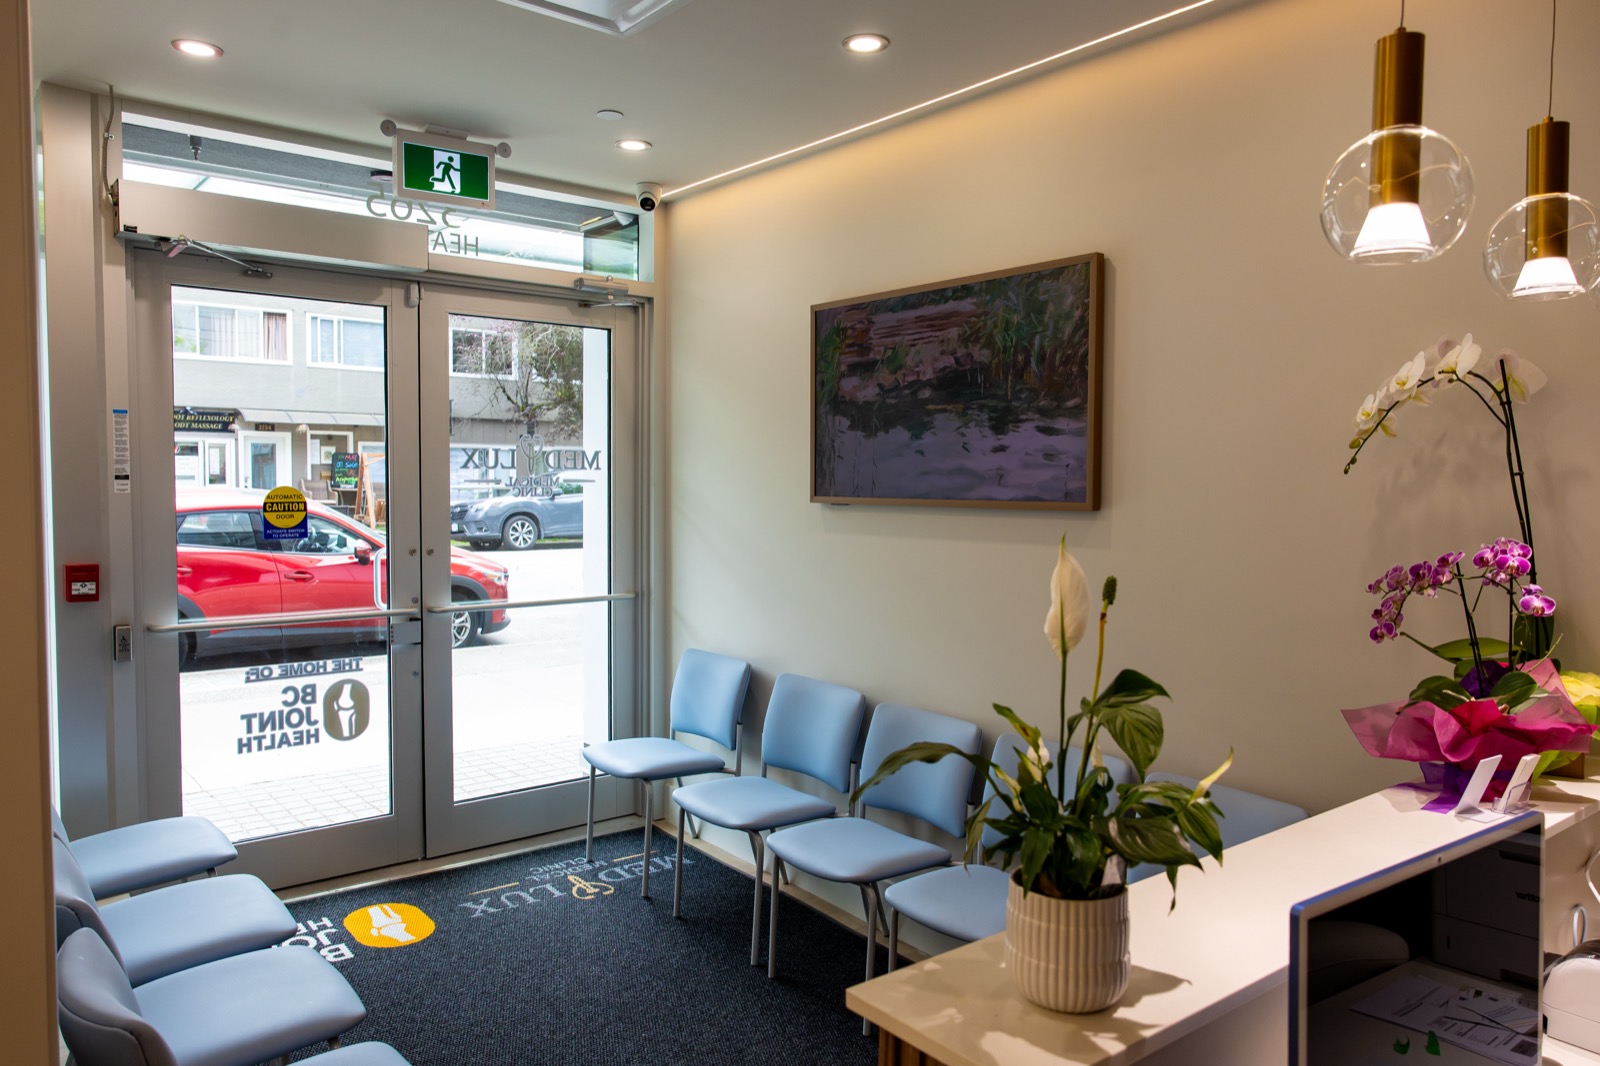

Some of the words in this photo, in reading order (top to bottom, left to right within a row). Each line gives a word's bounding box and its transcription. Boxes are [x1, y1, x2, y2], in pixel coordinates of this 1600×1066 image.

[186, 414, 235, 423] REFLEXOLOGY
[265, 502, 305, 512] CAUTION
[458, 883, 567, 918] LUX
